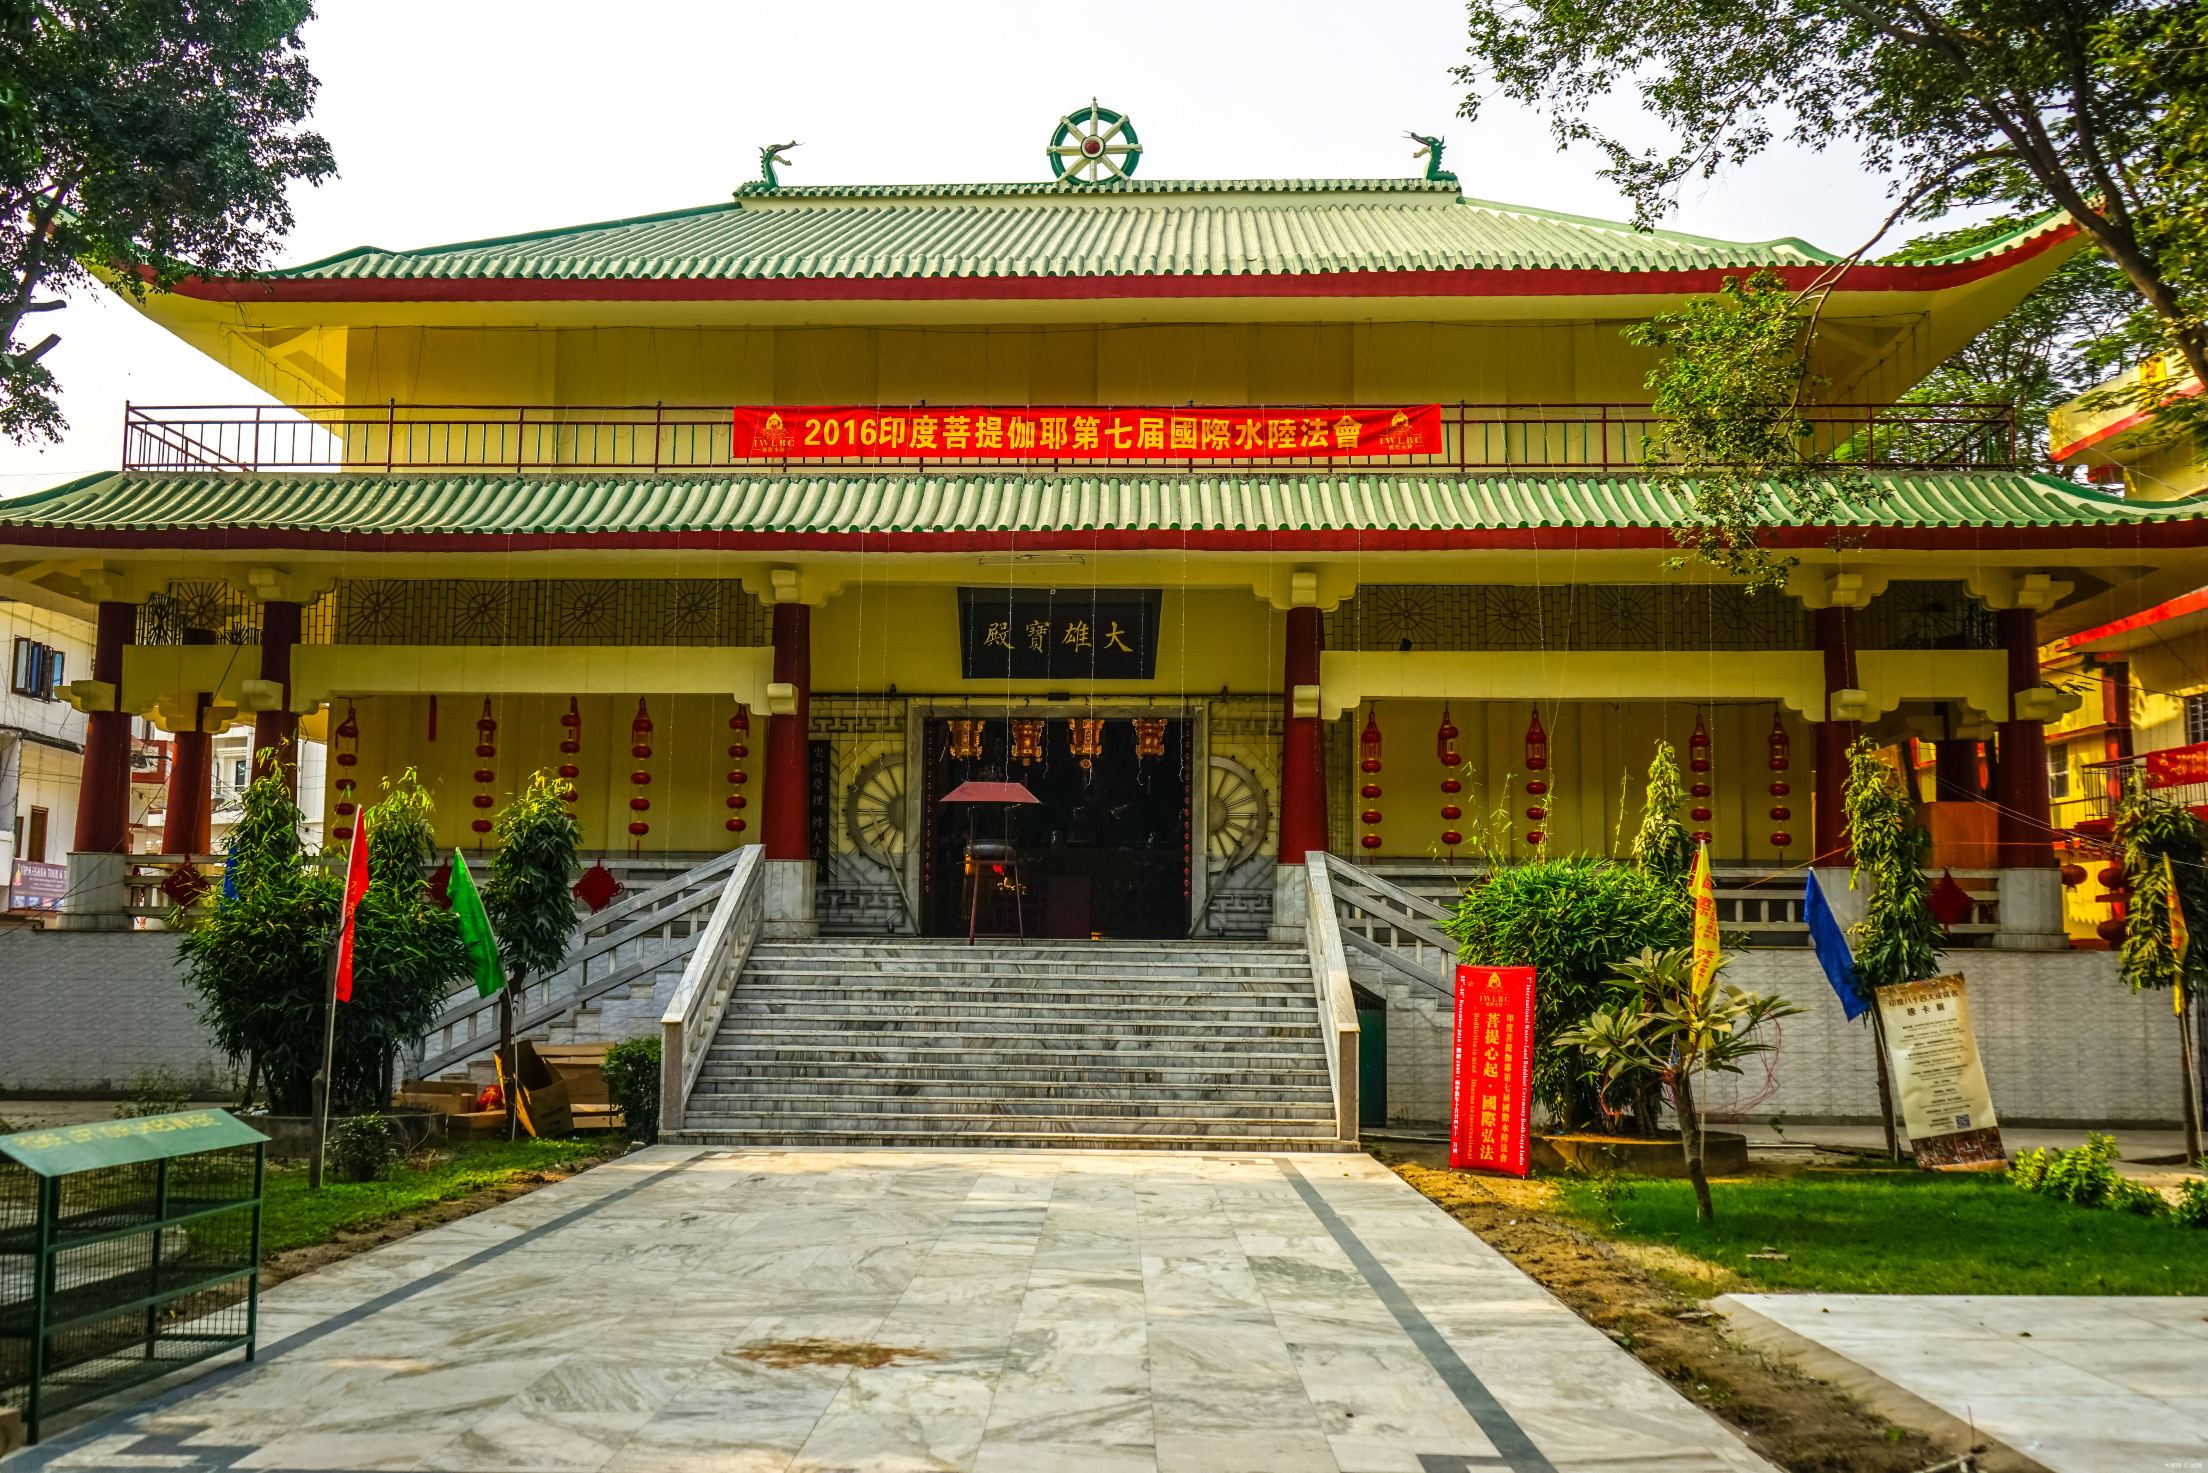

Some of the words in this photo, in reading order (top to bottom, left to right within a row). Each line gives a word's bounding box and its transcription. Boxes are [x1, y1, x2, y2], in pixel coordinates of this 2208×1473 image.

[804, 414, 1363, 450] 2016印度菩提伽耶第七届國際水陸法會
[753, 439, 795, 447] IWLBC
[1379, 436, 1423, 445] IWLBC
[1479, 995, 1510, 1003] IWLBC
